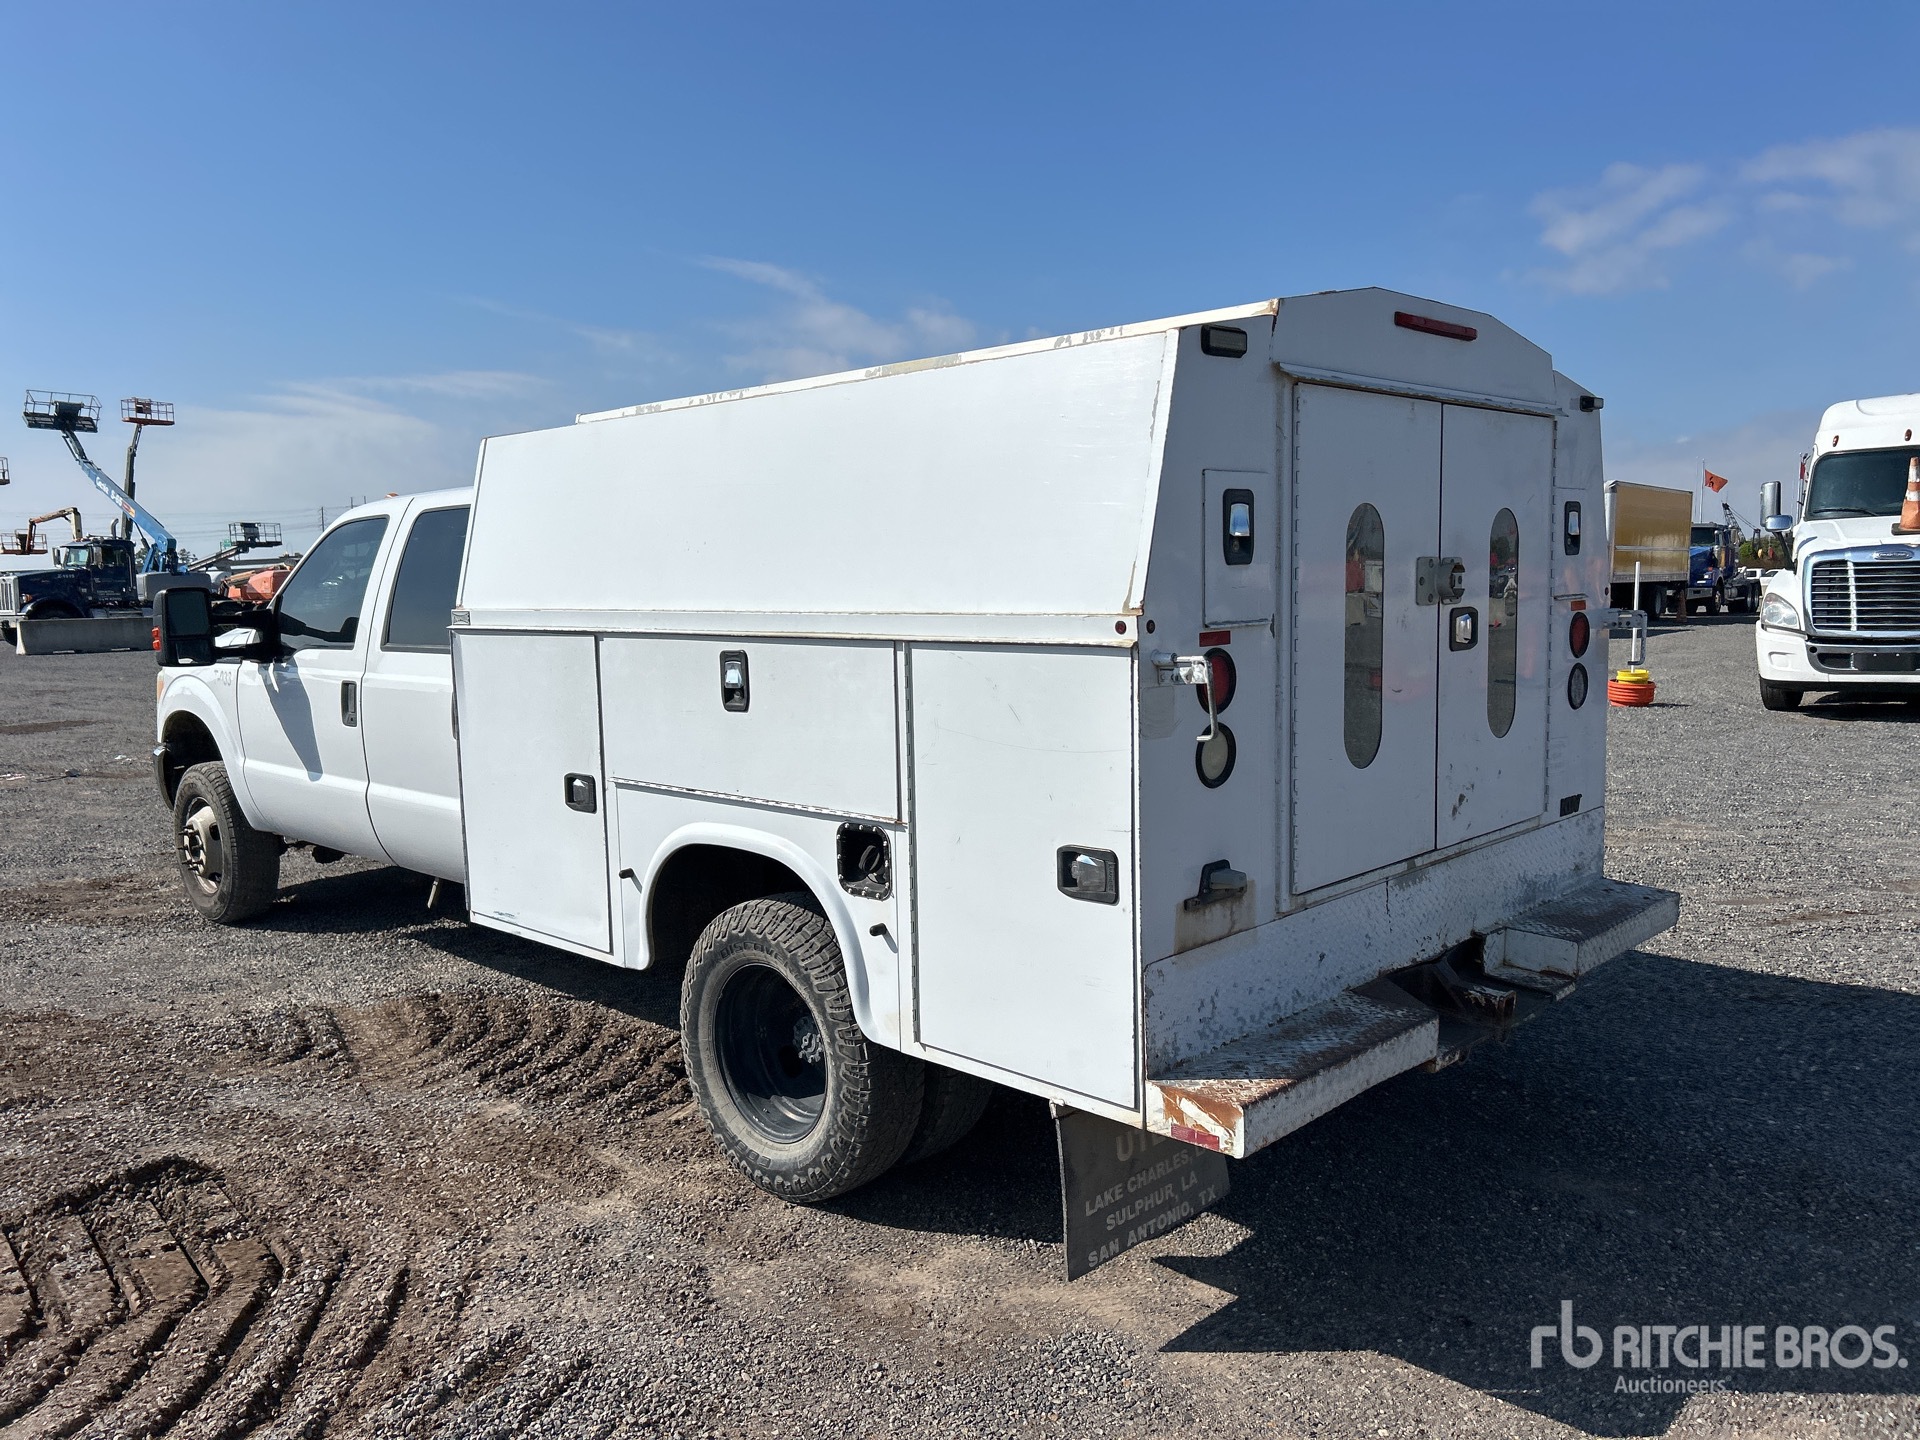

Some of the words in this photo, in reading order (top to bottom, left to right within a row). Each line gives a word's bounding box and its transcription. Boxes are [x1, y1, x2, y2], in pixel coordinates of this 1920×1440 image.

[1085, 1182, 1124, 1217] LAKE
[1127, 1151, 1193, 1193] CHARLES,
[1106, 1183, 1178, 1231] SULPHUR,
[1181, 1170, 1198, 1191] LA
[1088, 1238, 1120, 1267] SAN
[1127, 1201, 1194, 1246] ANTONIO,
[1199, 1184, 1217, 1205] TX
